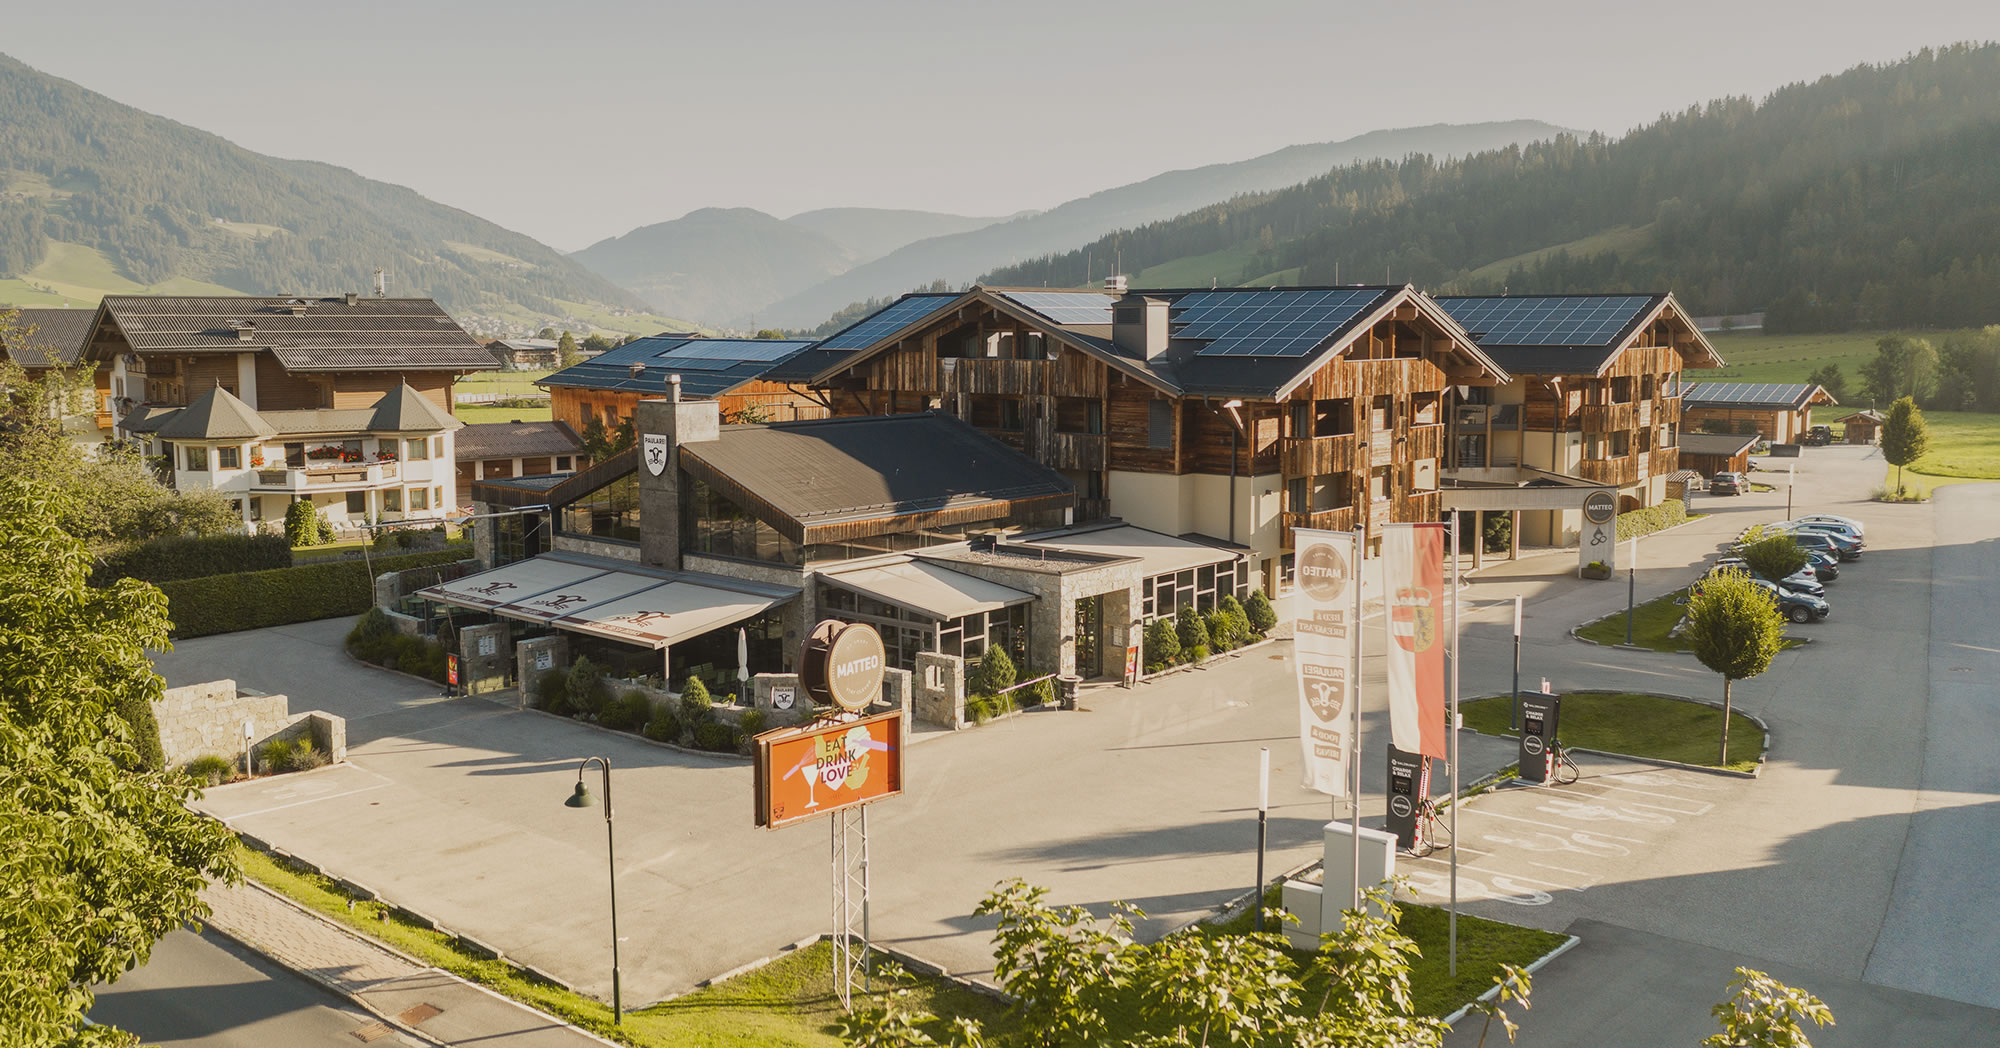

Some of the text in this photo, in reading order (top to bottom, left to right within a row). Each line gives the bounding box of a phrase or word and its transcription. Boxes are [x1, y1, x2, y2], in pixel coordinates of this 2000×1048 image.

[836, 655, 879, 679] MATTEO
[825, 736, 848, 752] EAT
[816, 748, 857, 770] DRINK
[820, 764, 853, 784] LOVE
